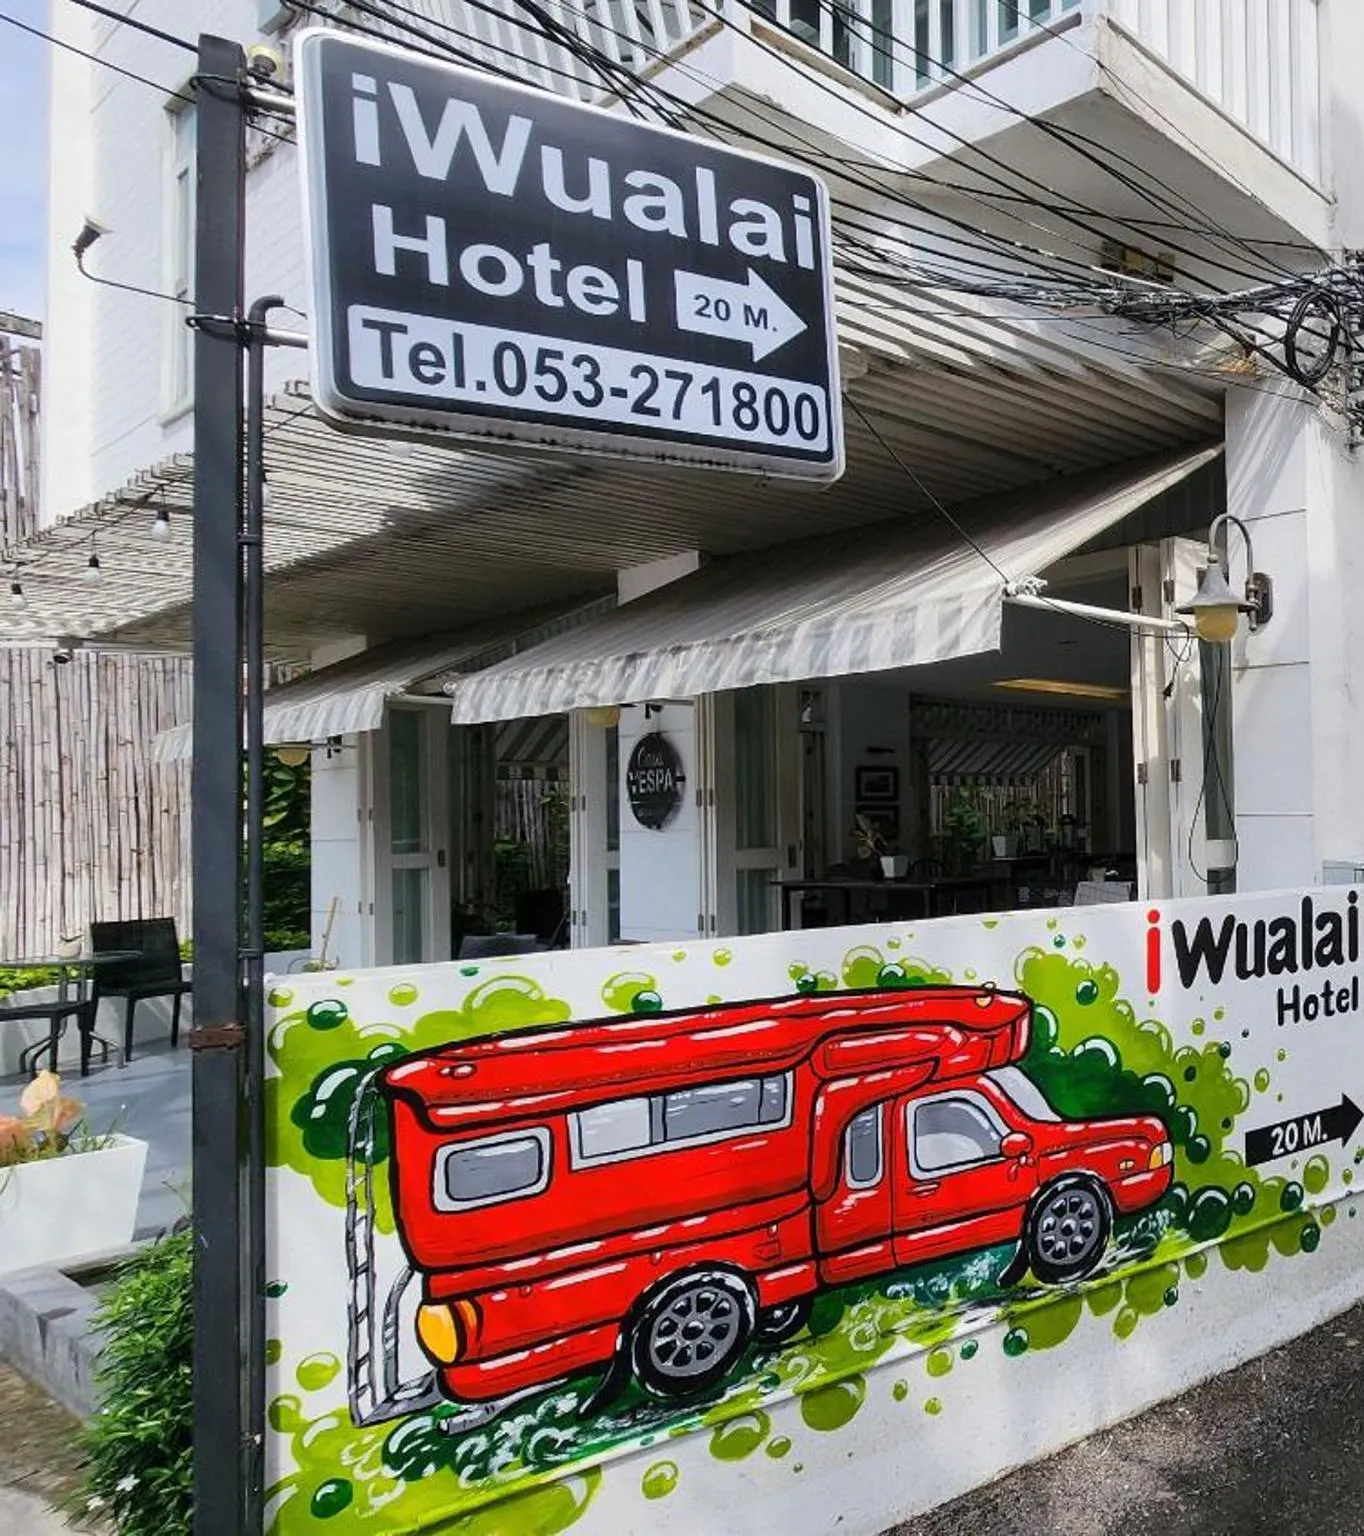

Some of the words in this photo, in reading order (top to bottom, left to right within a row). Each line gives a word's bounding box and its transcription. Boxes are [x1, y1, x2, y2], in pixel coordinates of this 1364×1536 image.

[351, 73, 815, 270] iWualai
[371, 204, 647, 324] Hotel
[693, 293, 732, 323] 20
[744, 302, 778, 332] M.
[361, 317, 820, 442] Tel.053-271800
[1172, 890, 1359, 989] Wualai
[1277, 976, 1359, 1027] Hotel
[1271, 1121, 1299, 1155] 20
[1303, 1115, 1329, 1148] M.
